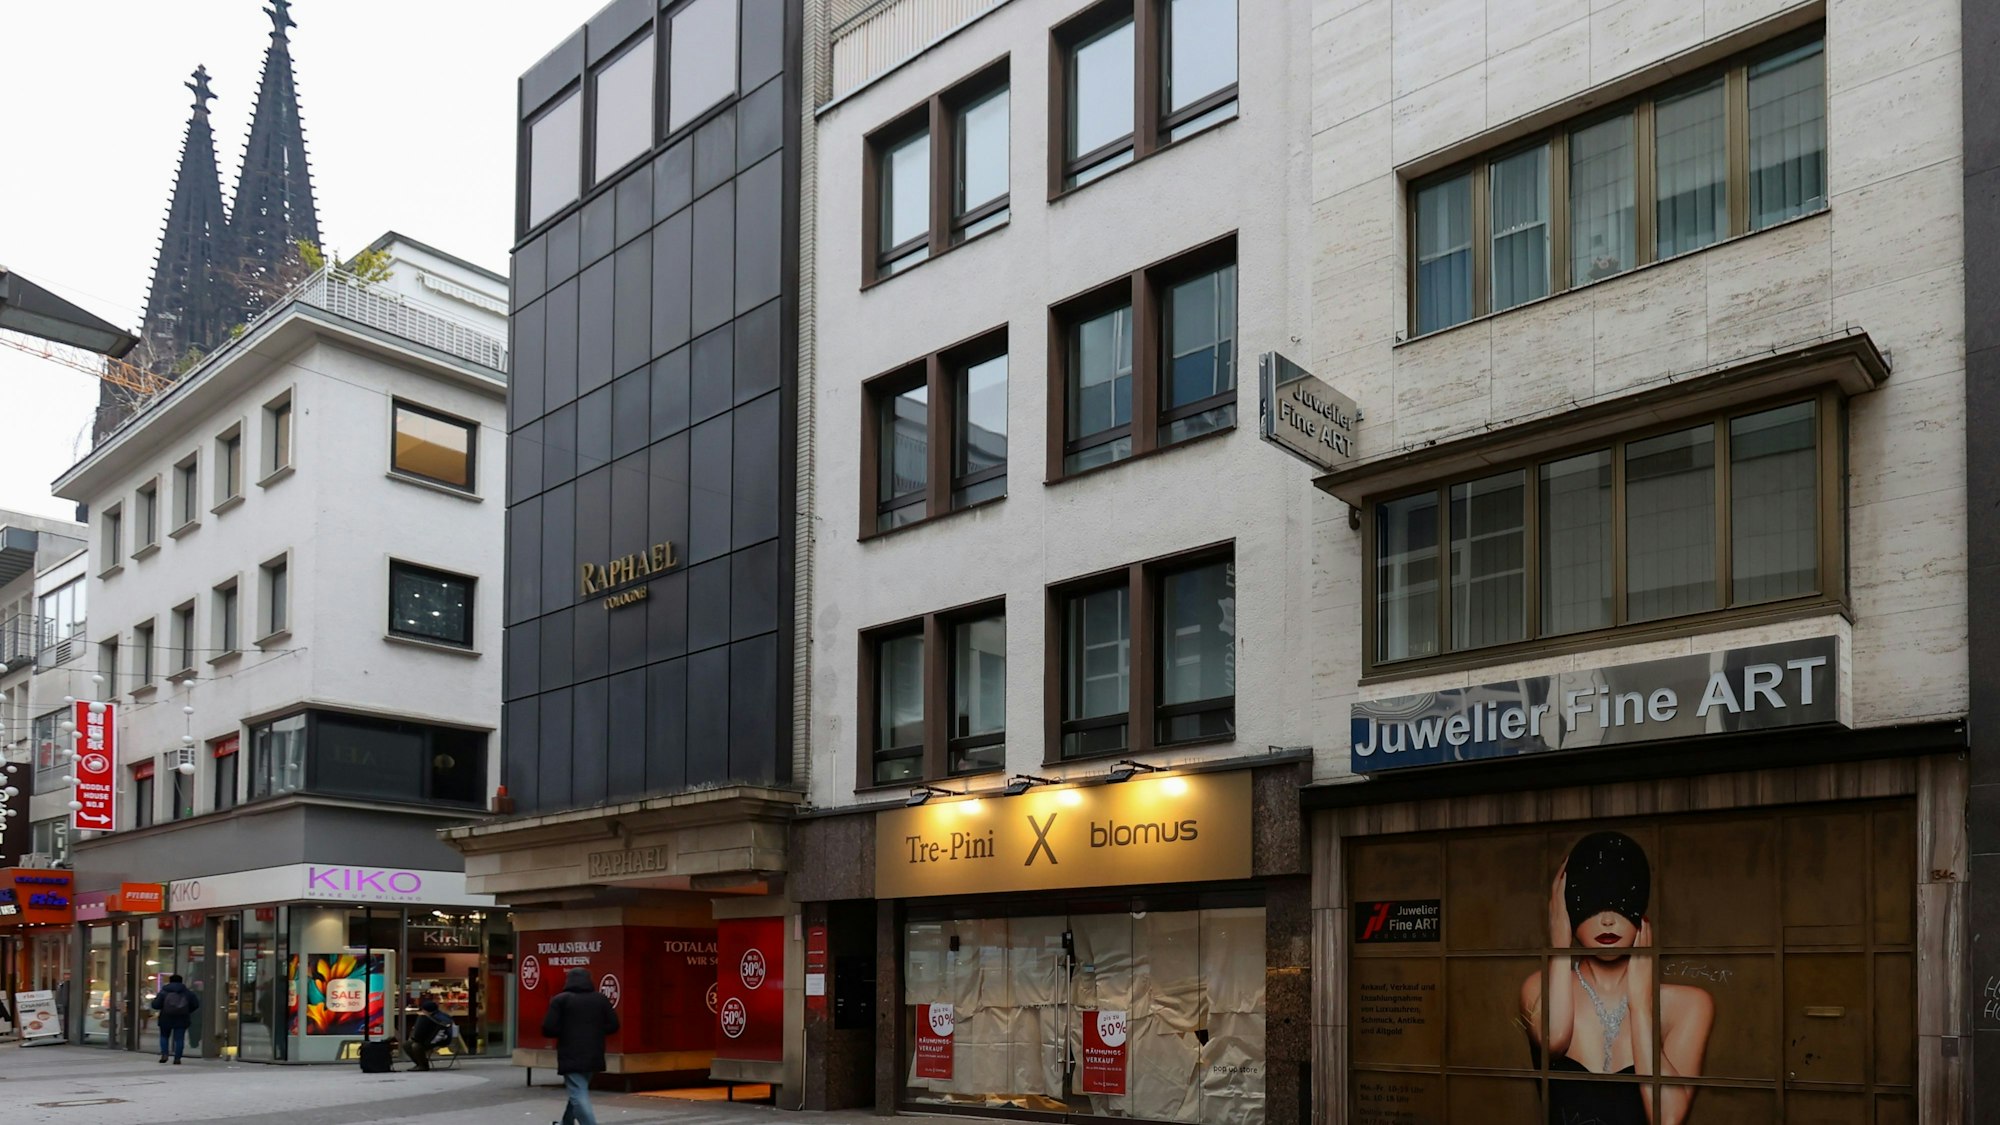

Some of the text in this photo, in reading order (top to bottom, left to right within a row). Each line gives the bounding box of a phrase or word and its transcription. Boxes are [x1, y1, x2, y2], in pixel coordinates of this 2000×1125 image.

[1293, 384, 1353, 430] Juwelier
[1279, 399, 1353, 458] Fine ART
[580, 540, 678, 596] RAPHAEL
[603, 586, 648, 610] COLOGNE
[1354, 656, 1827, 757] Juwelier Fine ART
[83, 792, 109, 801] HOUSE
[906, 813, 1198, 866] Tre-Pini X blomus
[591, 847, 668, 878] RAPHAEL
[309, 867, 422, 895] KIKO
[170, 880, 201, 903] KIKO
[375, 894, 422, 902] MILANO
[1397, 904, 1439, 917] Juwelier
[1389, 917, 1439, 931] Fine ART
[686, 956, 707, 965] WIR
[742, 961, 764, 977] 30%
[1390, 983, 1419, 991] Verkauf
[331, 991, 361, 1000] SALE
[724, 1010, 744, 1025] 50%
[932, 1013, 955, 1028] 50%
[1101, 1020, 1127, 1037] 50%
[918, 1036, 952, 1045] RÄUMUNGS-
[918, 1045, 944, 1053] VERKAUF
[1085, 1047, 1124, 1056] RÄUMUNGS-
[1086, 1056, 1115, 1065] VERKAUF
[1213, 1066, 1258, 1074] pop up store
